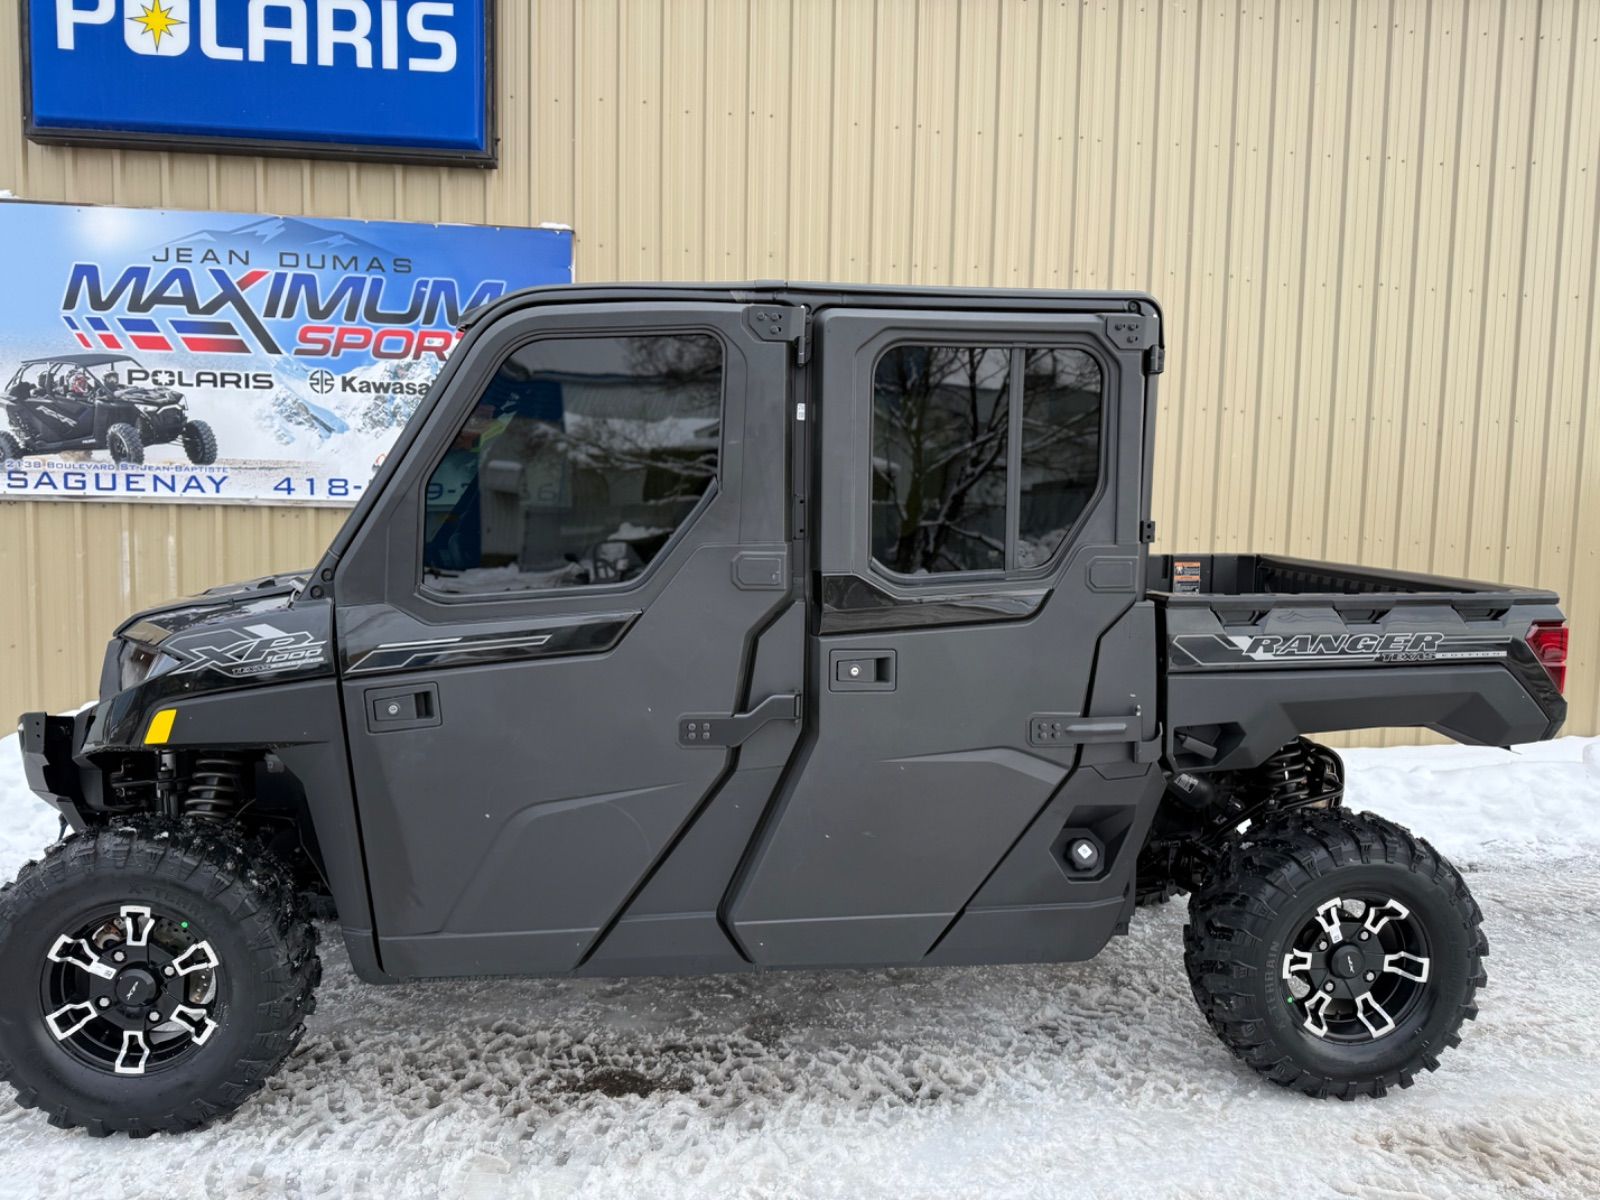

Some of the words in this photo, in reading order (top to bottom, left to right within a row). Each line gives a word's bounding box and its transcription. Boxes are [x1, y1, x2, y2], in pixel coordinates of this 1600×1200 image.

[56, 0, 458, 73] POLARIS
[152, 247, 250, 267] JEAN
[279, 252, 412, 274] DUMAS
[62, 263, 506, 355] MAXIMUM
[294, 325, 465, 361] SPOR
[127, 368, 274, 390] POLARIS
[341, 376, 434, 396] Kawasa
[6, 460, 41, 469] 2138
[7, 471, 229, 494] SAGUENAY
[1242, 632, 1445, 655] RANGER
[266, 648, 323, 663] 1000
[1382, 651, 1437, 662] TEXAS
